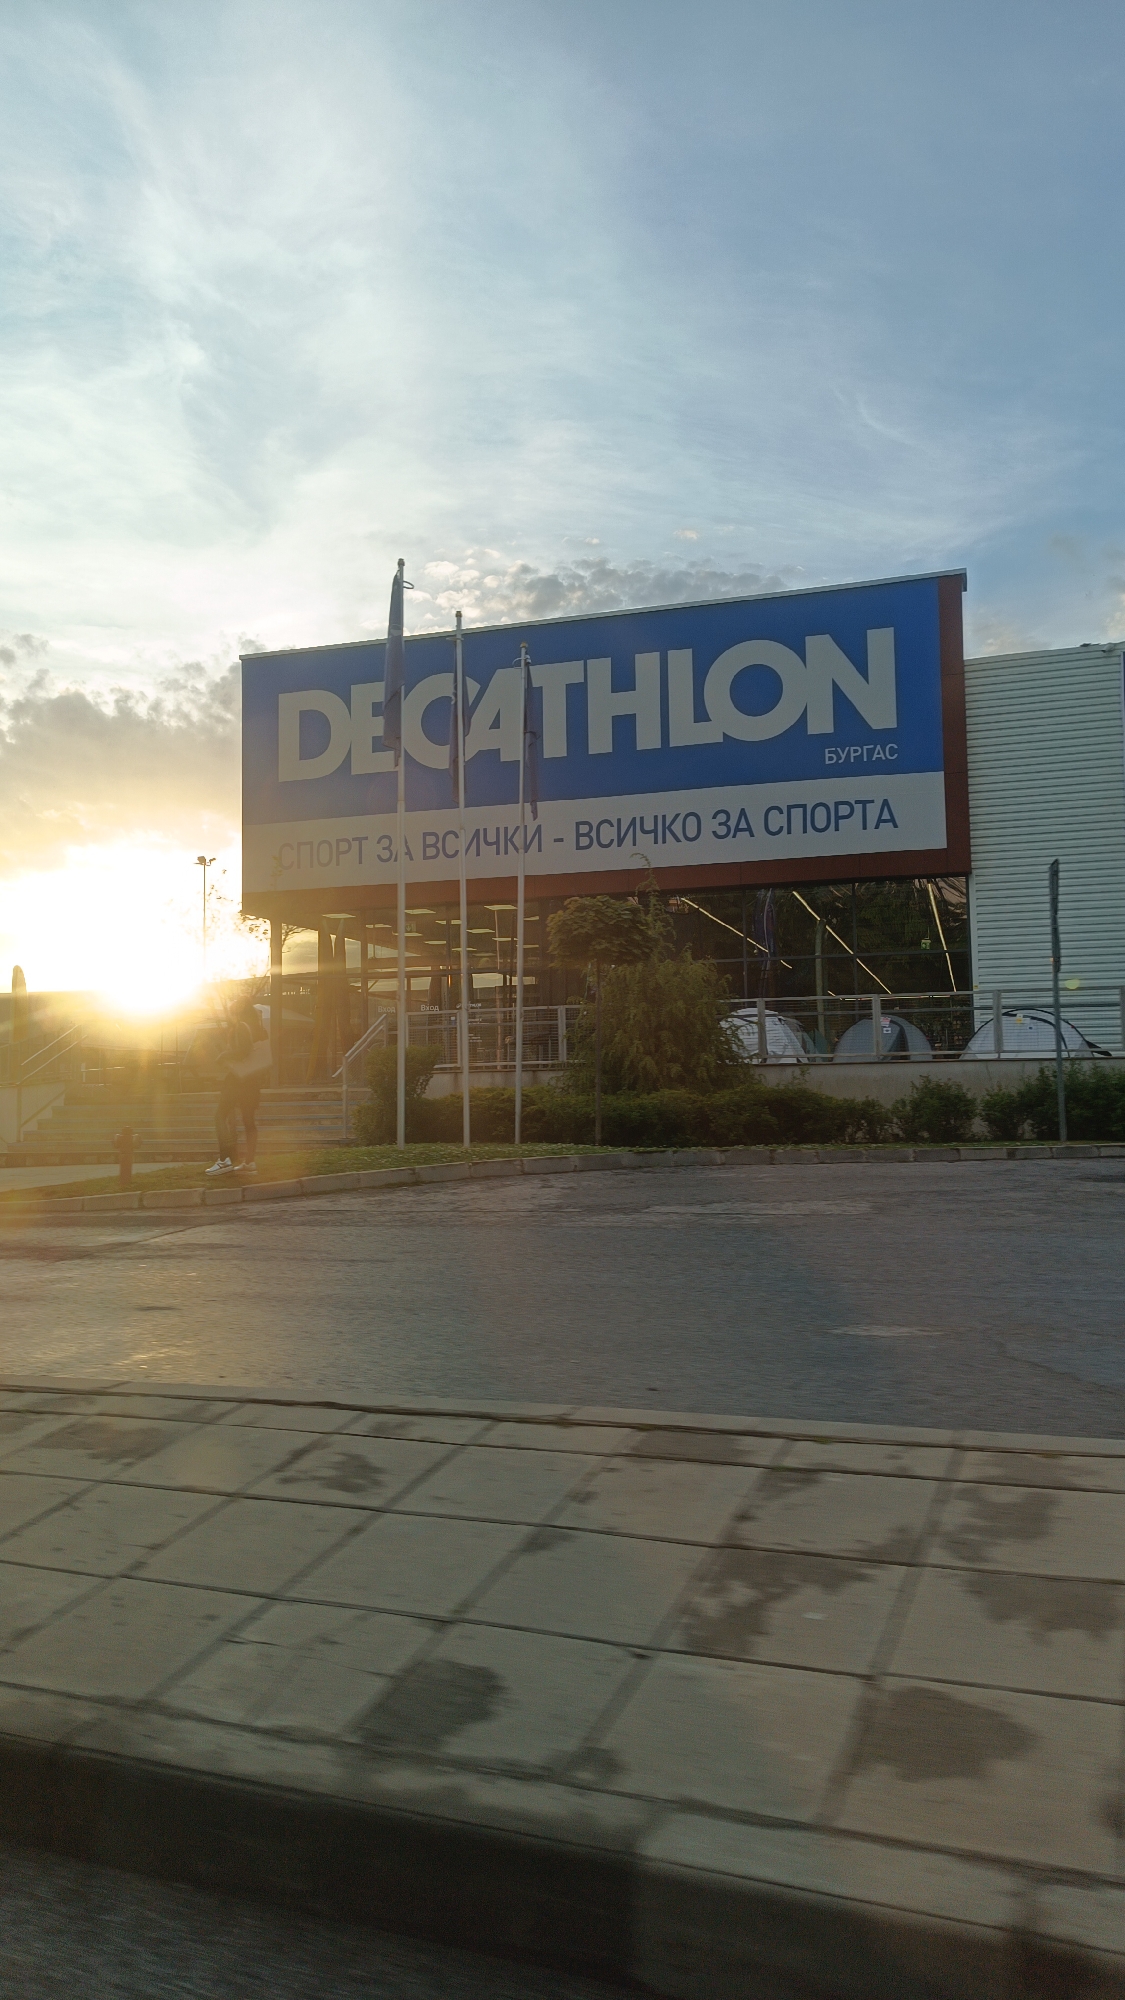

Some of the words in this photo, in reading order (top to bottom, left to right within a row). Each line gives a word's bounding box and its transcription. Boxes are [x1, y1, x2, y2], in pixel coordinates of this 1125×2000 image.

[278, 626, 898, 782] DECATHLON
[824, 743, 899, 765] БУРГАС
[279, 836, 368, 870] СПОРТ
[376, 834, 414, 863] ЗА
[422, 824, 543, 861] ВСИЧКИ
[574, 811, 702, 851] ВСИЧКО
[711, 807, 755, 840] ЗА
[763, 798, 899, 836] СПОРТА
[377, 1005, 396, 1014] Вход
[420, 1004, 440, 1012] Вход
